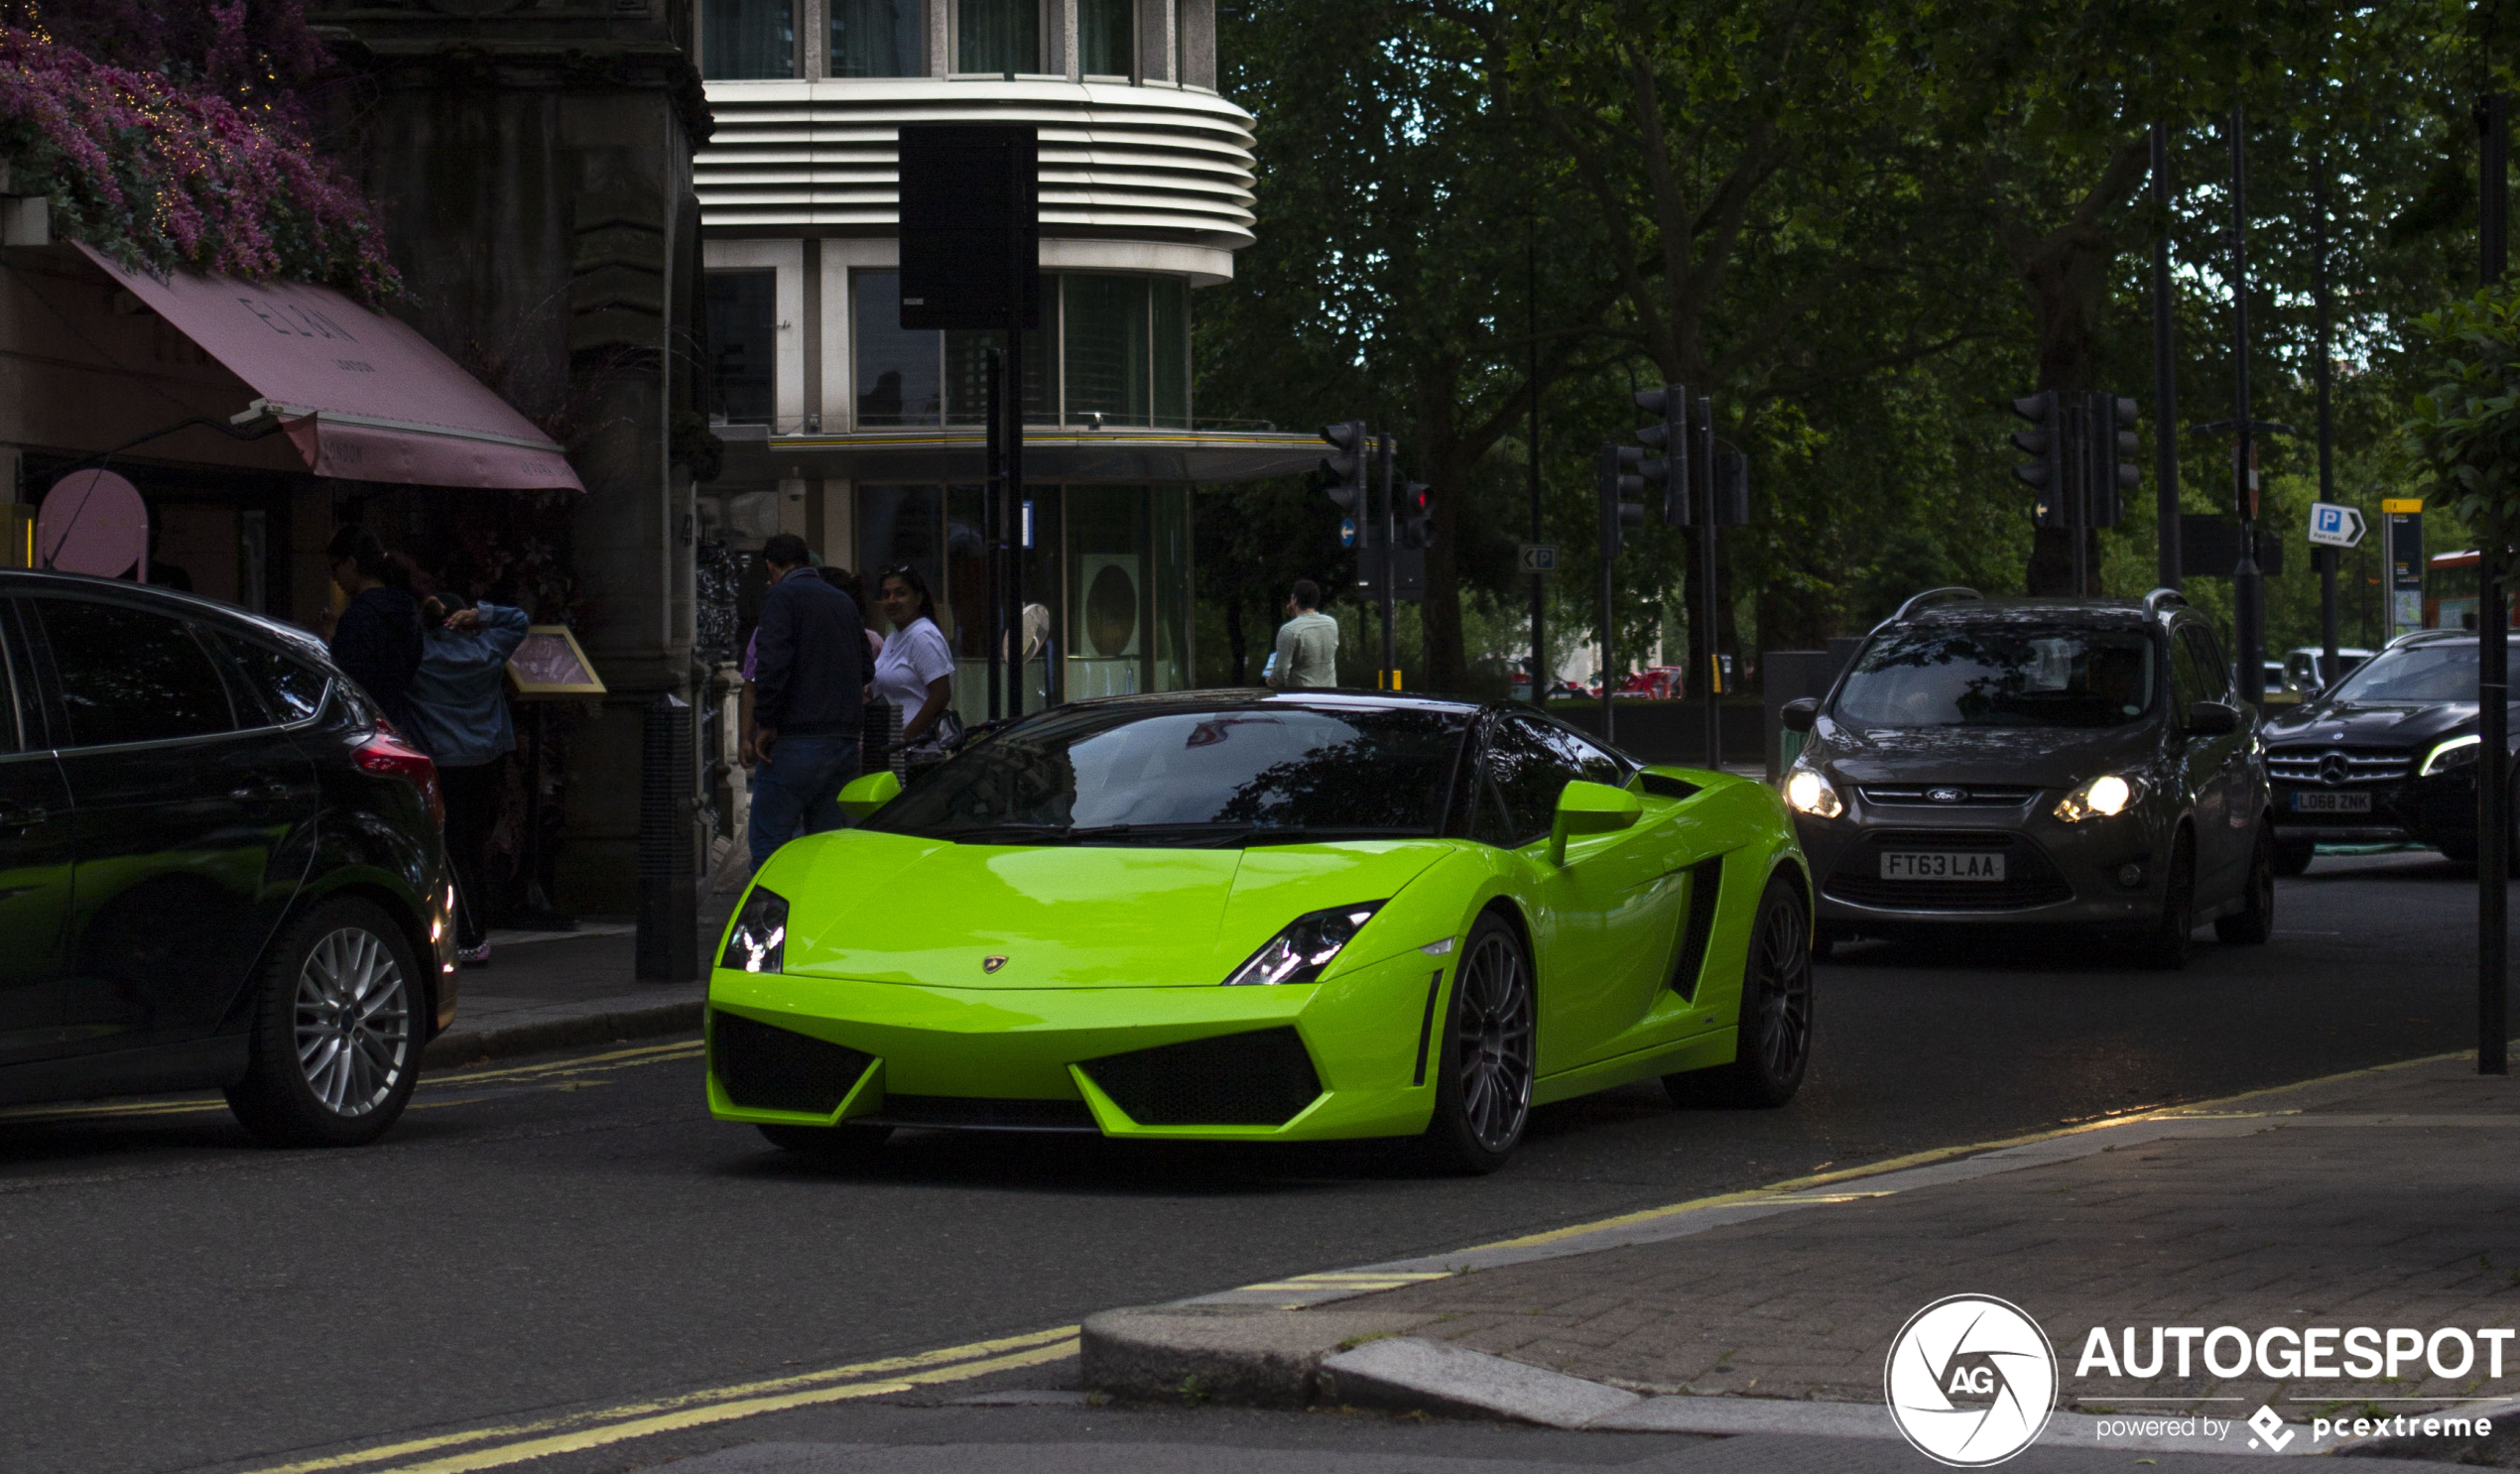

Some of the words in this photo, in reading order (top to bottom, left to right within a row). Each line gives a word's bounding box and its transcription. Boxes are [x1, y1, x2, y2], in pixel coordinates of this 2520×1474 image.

[2323, 511, 2337, 529] P
[1934, 789, 1958, 799] Ford
[2299, 794, 2336, 809] LO68
[2338, 794, 2368, 809] ZNK
[1889, 854, 1946, 876] FT63
[1952, 855, 1995, 877] LAA
